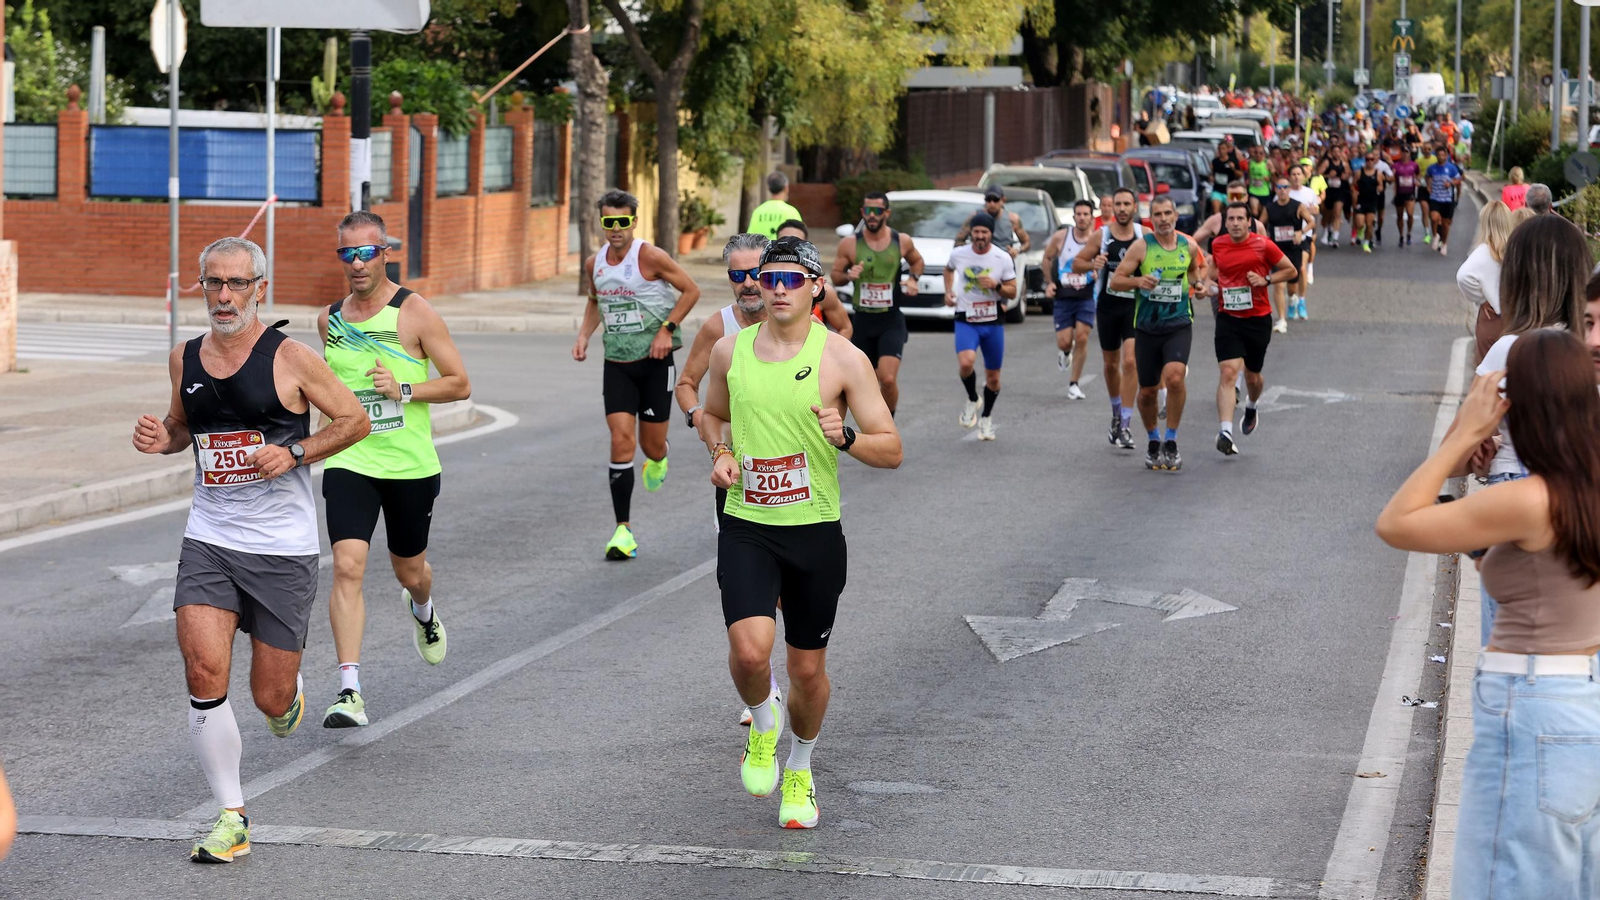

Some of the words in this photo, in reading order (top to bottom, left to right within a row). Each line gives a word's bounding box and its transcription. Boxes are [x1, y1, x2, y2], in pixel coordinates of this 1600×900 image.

[1161, 287, 1172, 295] 75
[1231, 295, 1242, 303] 76
[615, 313, 627, 323] 27
[213, 449, 248, 469] 250
[756, 472, 793, 491] 204
